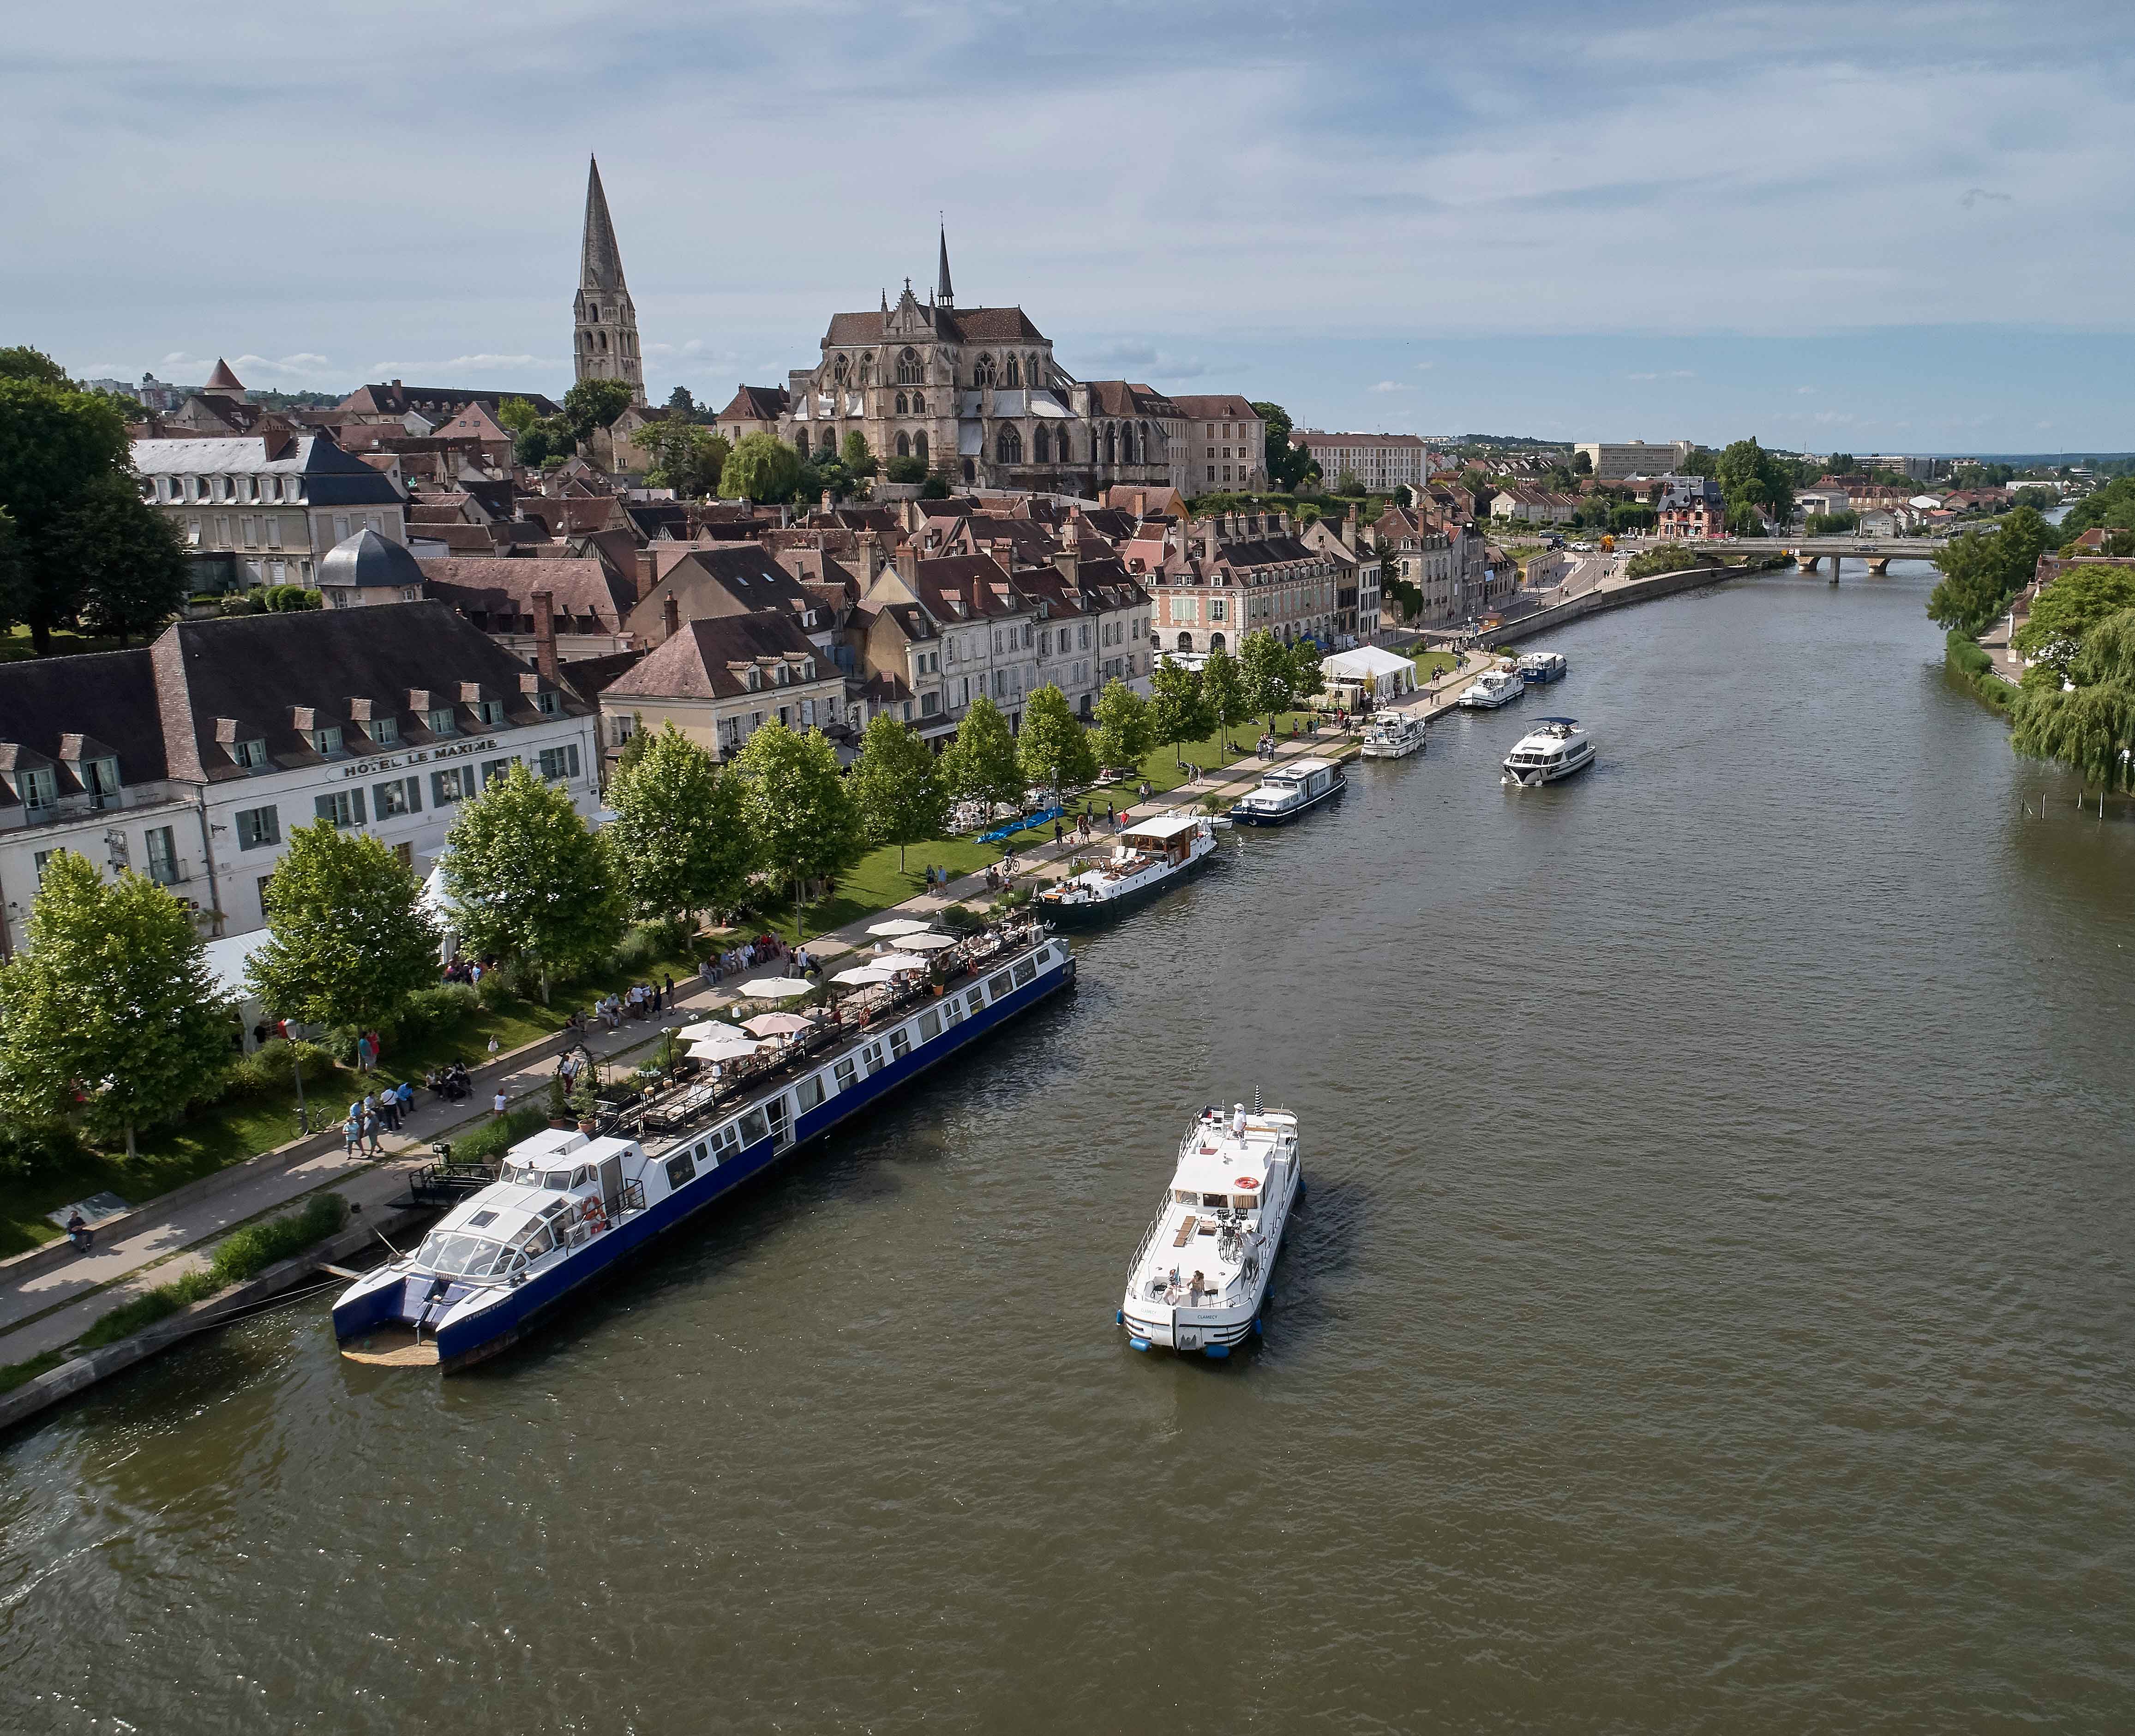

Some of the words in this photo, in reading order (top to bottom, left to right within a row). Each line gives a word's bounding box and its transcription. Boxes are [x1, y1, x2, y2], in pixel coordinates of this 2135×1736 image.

[345, 758, 402, 777] HOTEL
[408, 753, 428, 763] LE
[435, 739, 498, 759] MAXIME
